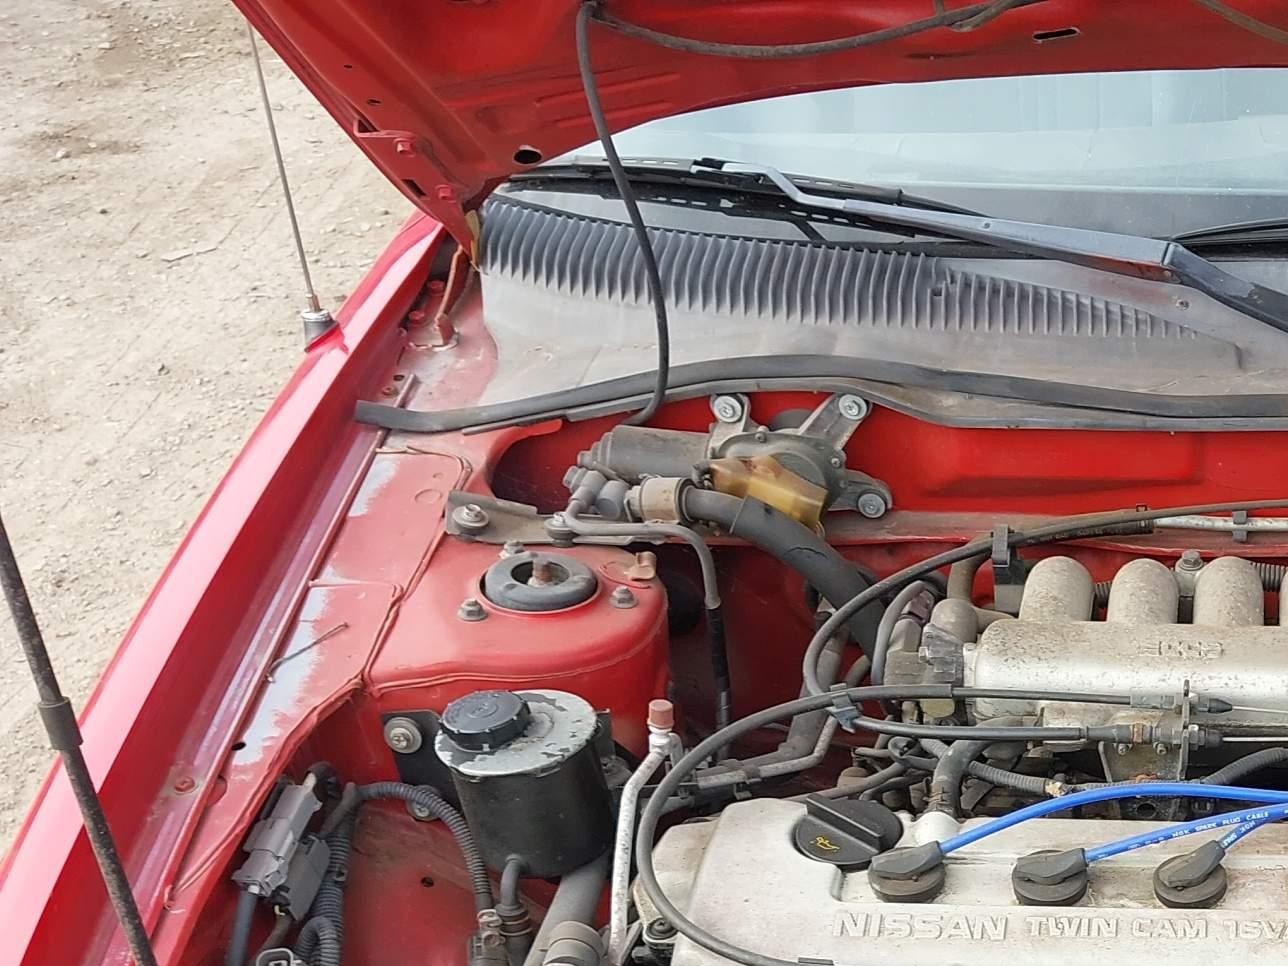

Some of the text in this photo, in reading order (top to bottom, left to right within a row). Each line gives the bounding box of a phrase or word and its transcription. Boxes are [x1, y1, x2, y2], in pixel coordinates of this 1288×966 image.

[832, 911, 1010, 942] NISSAN
[1024, 915, 1120, 939] TWIN
[1130, 916, 1209, 940] CAM
